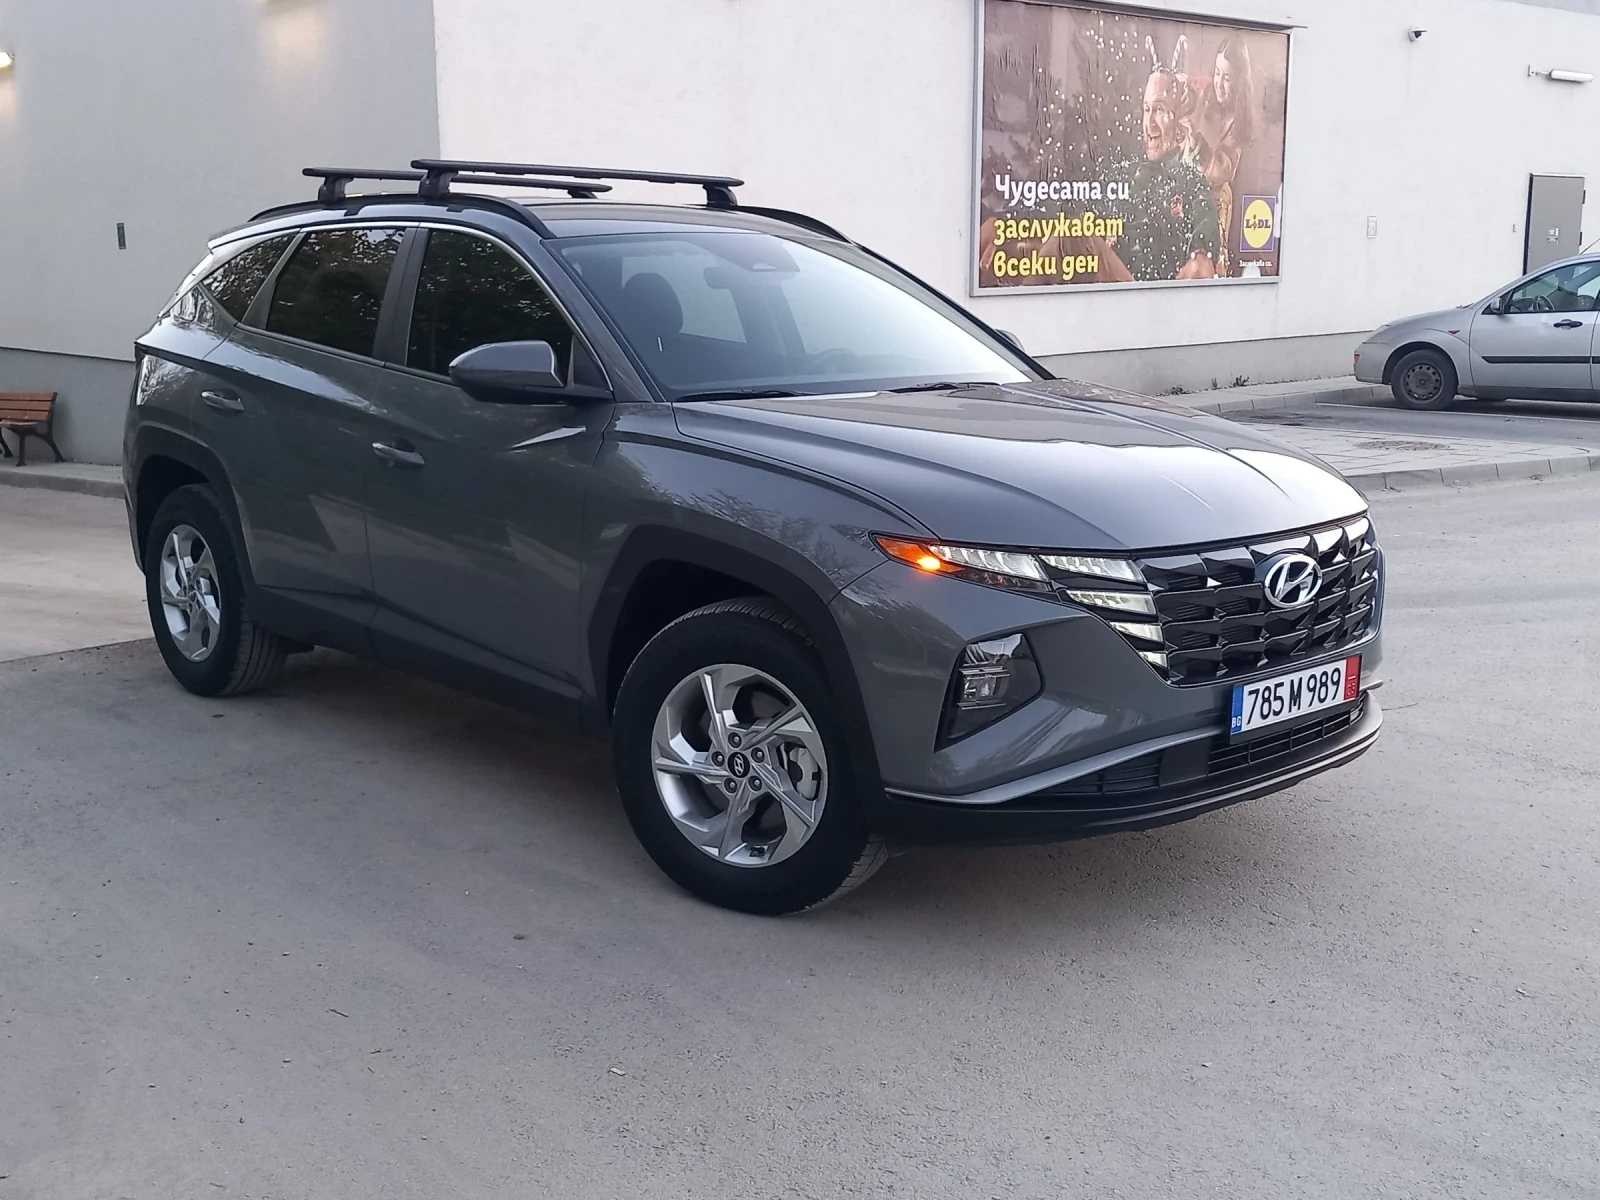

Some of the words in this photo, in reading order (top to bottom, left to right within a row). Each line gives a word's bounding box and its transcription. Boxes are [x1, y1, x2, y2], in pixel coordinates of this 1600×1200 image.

[995, 174, 1101, 207] Чудесата
[1106, 181, 1130, 200] си
[993, 211, 1123, 246] заслужават
[993, 250, 1057, 277] всеки
[1062, 255, 1099, 281] ден
[1231, 715, 1242, 728] BG
